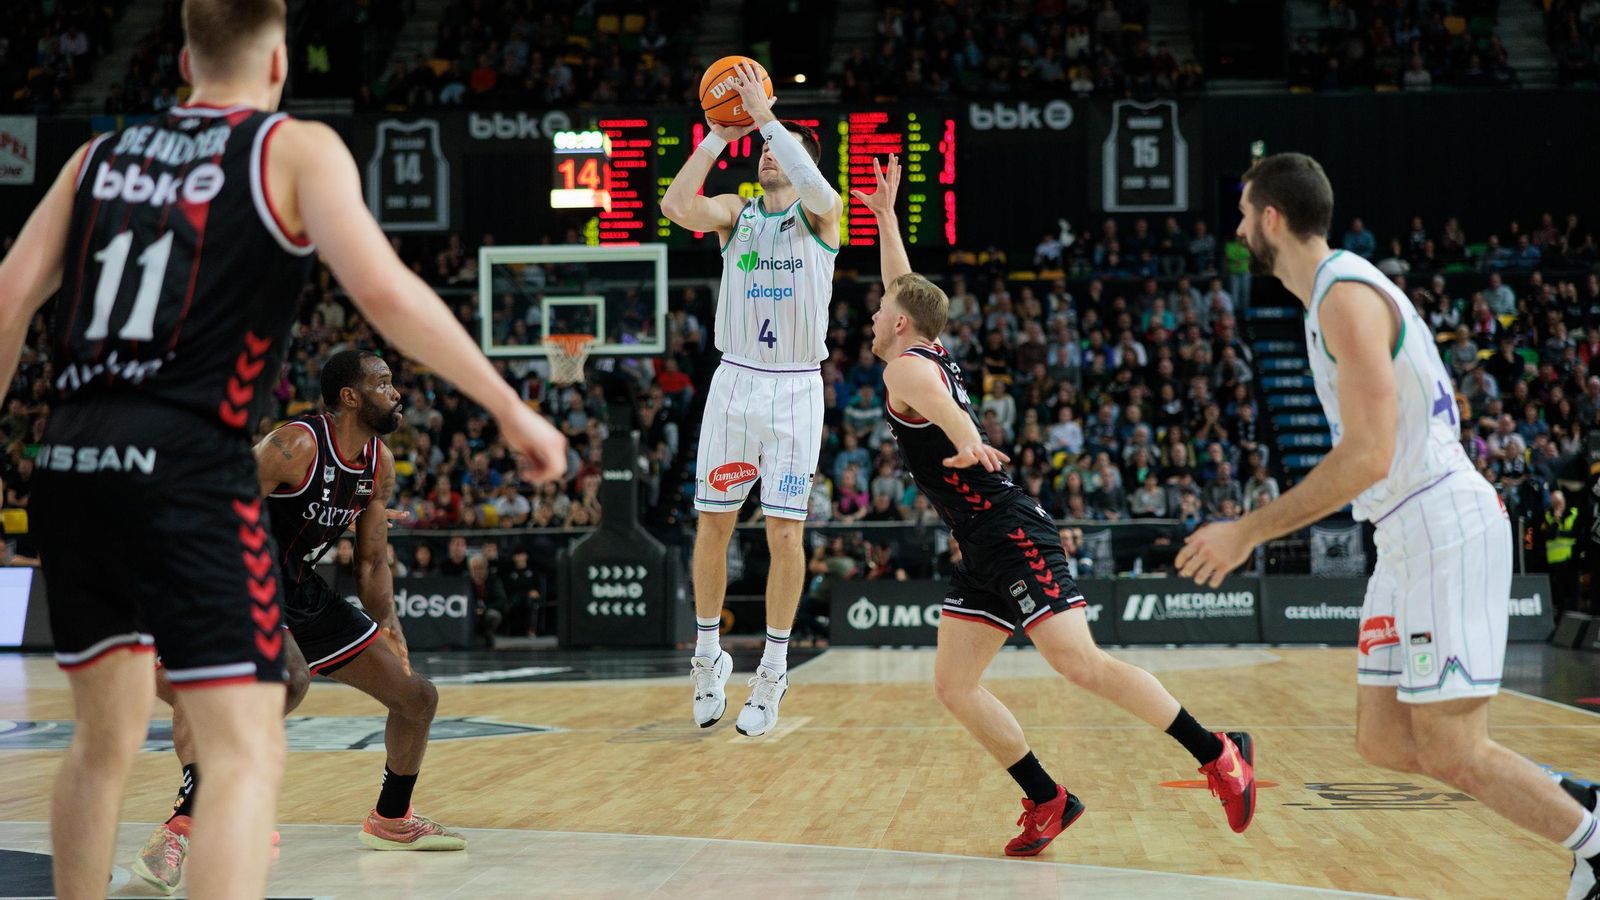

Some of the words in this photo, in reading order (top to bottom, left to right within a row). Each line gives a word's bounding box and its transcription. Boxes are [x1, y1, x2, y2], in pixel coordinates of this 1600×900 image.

[468, 112, 540, 139] bbk
[968, 103, 1042, 130] bbk
[1131, 135, 1159, 168] 15
[92, 161, 182, 206] bbk
[393, 152, 423, 185] 14
[557, 158, 600, 190] 14
[84, 230, 174, 341] 11
[758, 318, 777, 349] 4
[393, 588, 469, 618] desa
[1165, 591, 1254, 610] MEDRANO
